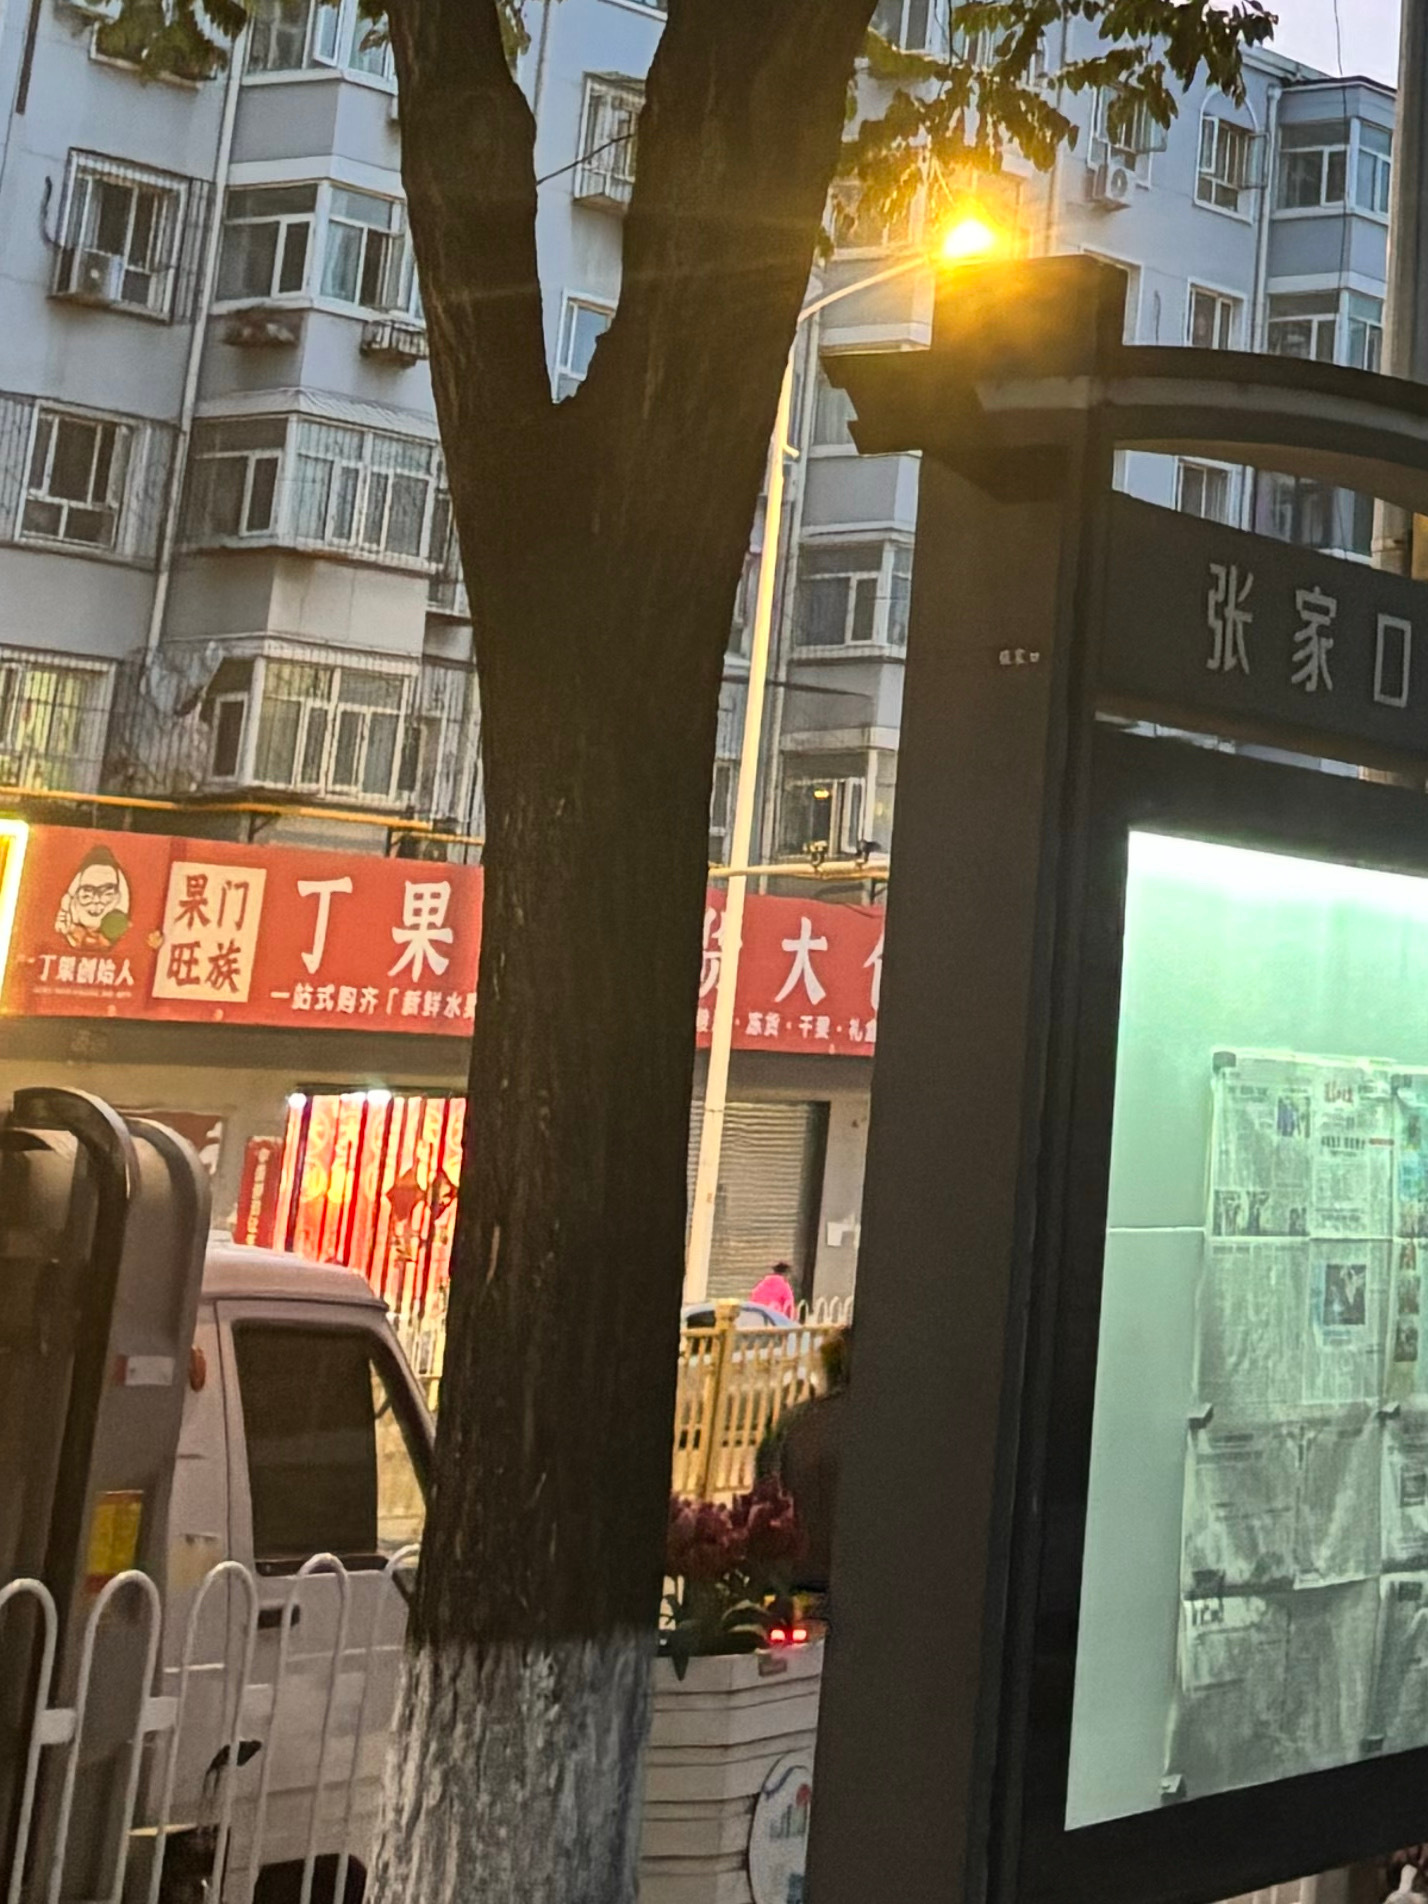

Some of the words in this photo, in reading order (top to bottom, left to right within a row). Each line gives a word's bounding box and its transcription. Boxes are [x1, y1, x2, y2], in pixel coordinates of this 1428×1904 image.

[174, 873, 250, 932] 果门
[297, 876, 454, 984] 丁果
[167, 939, 243, 994] 旺族
